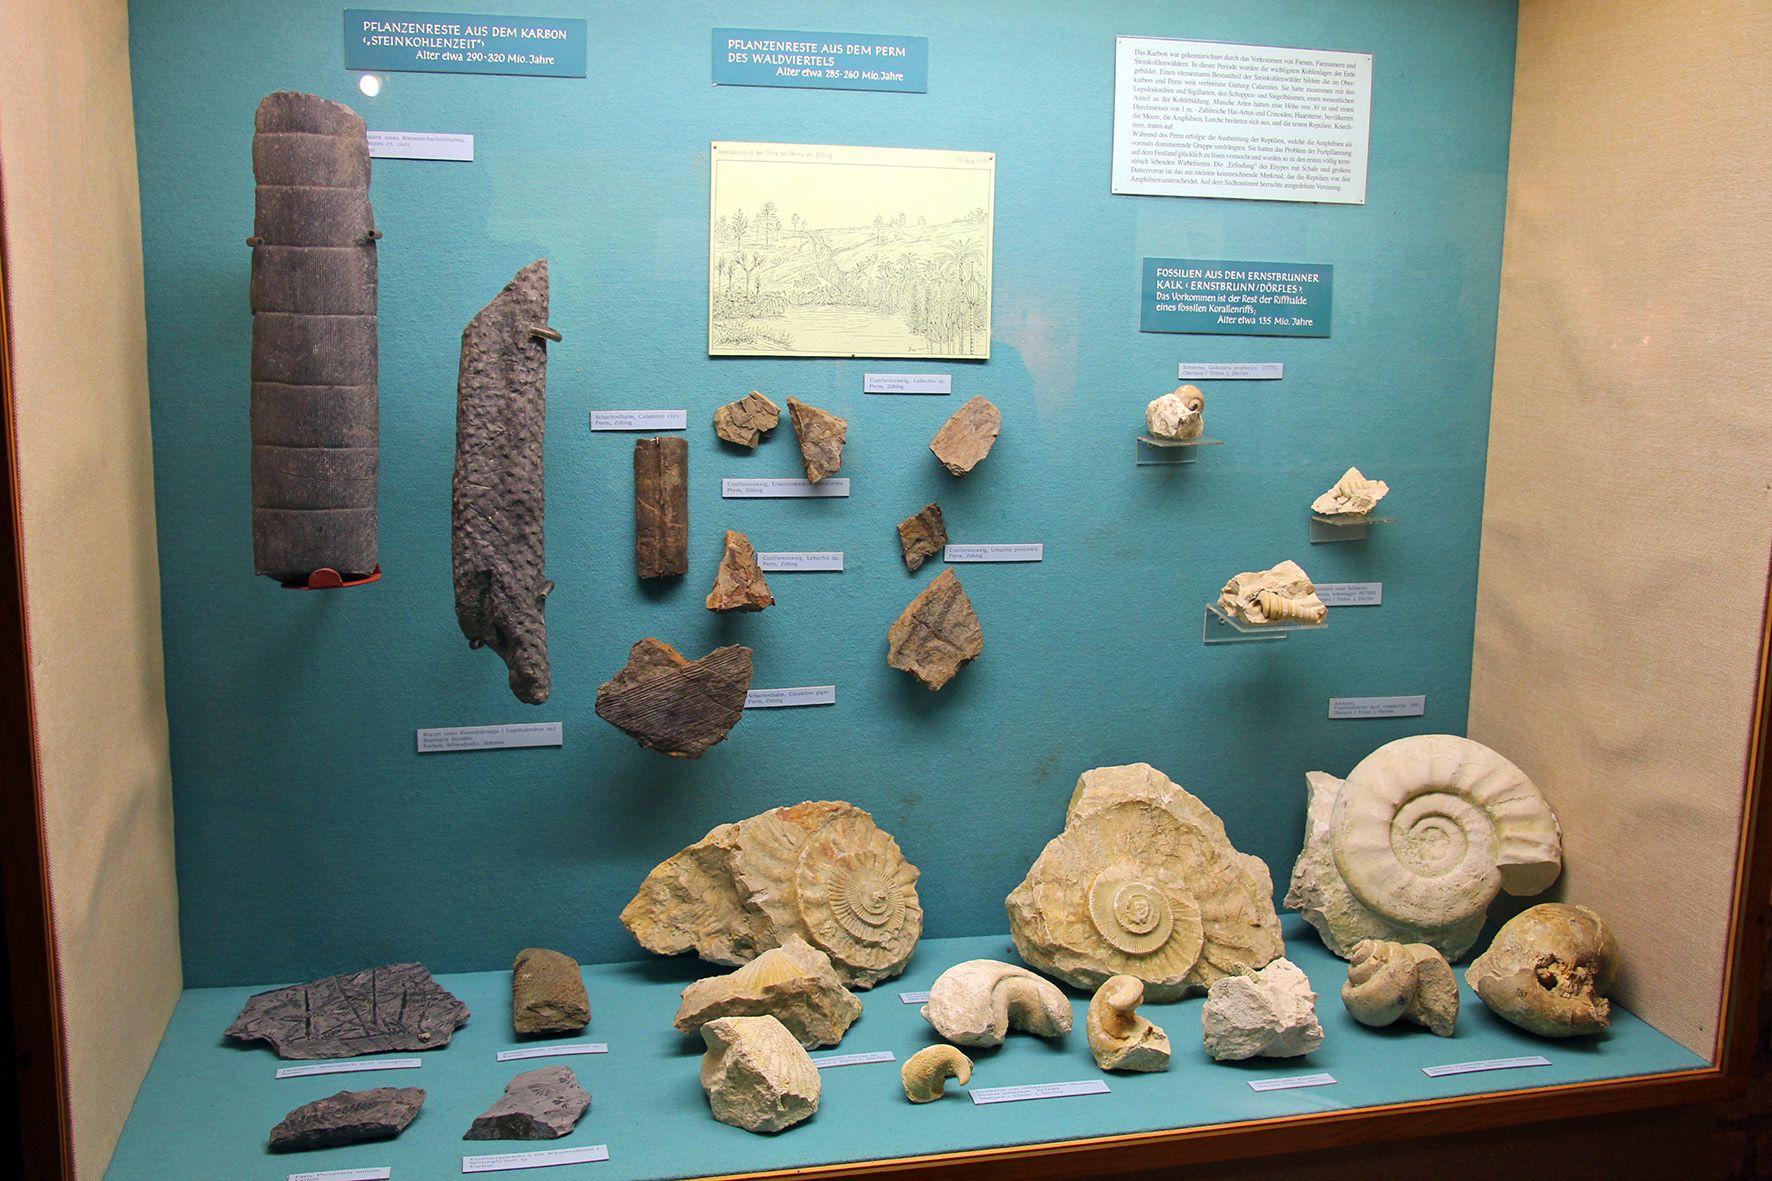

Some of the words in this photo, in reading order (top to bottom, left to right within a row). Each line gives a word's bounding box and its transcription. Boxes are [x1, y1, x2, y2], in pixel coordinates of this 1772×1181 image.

[363, 21, 461, 36] PFLANZENRESTE
[464, 26, 488, 37] AUS
[492, 27, 517, 38] DEM
[521, 28, 567, 40] KARBON
[728, 40, 818, 53] PFLANZENRESTE
[821, 44, 844, 54] AUS
[846, 45, 872, 56] DEM
[876, 46, 906, 57] PERM
[416, 50, 438, 60] Alter
[442, 52, 463, 62] etwa
[508, 54, 528, 64] Mio.
[528, 54, 554, 65] Jahre
[728, 52, 748, 63] DES
[752, 54, 834, 67] WALDVIERTELS
[776, 66, 800, 76] Alter
[802, 68, 822, 78] etwa
[826, 69, 860, 80] 285-260
[862, 71, 880, 80] Mio.
[880, 71, 904, 82] Jahre
[1156, 268, 1202, 278] FOSSILIEN
[1204, 270, 1222, 279] AUS
[1224, 270, 1245, 280] DEM
[1248, 272, 1319, 283] ERNSTBRUNNER
[1156, 280, 1183, 290] KALK
[1156, 292, 1170, 300] Das
[1171, 292, 1216, 302] Vorkommen
[1218, 294, 1226, 302] ist
[1228, 294, 1241, 303] der
[1258, 296, 1272, 304] der
[1274, 296, 1307, 305] Riffhalde
[1178, 304, 1207, 312] fossilen
[1217, 316, 1237, 324] Alter
[1238, 316, 1256, 324] etwa
[1274, 317, 1290, 326] Mio.
[1292, 318, 1313, 326] Jahre
